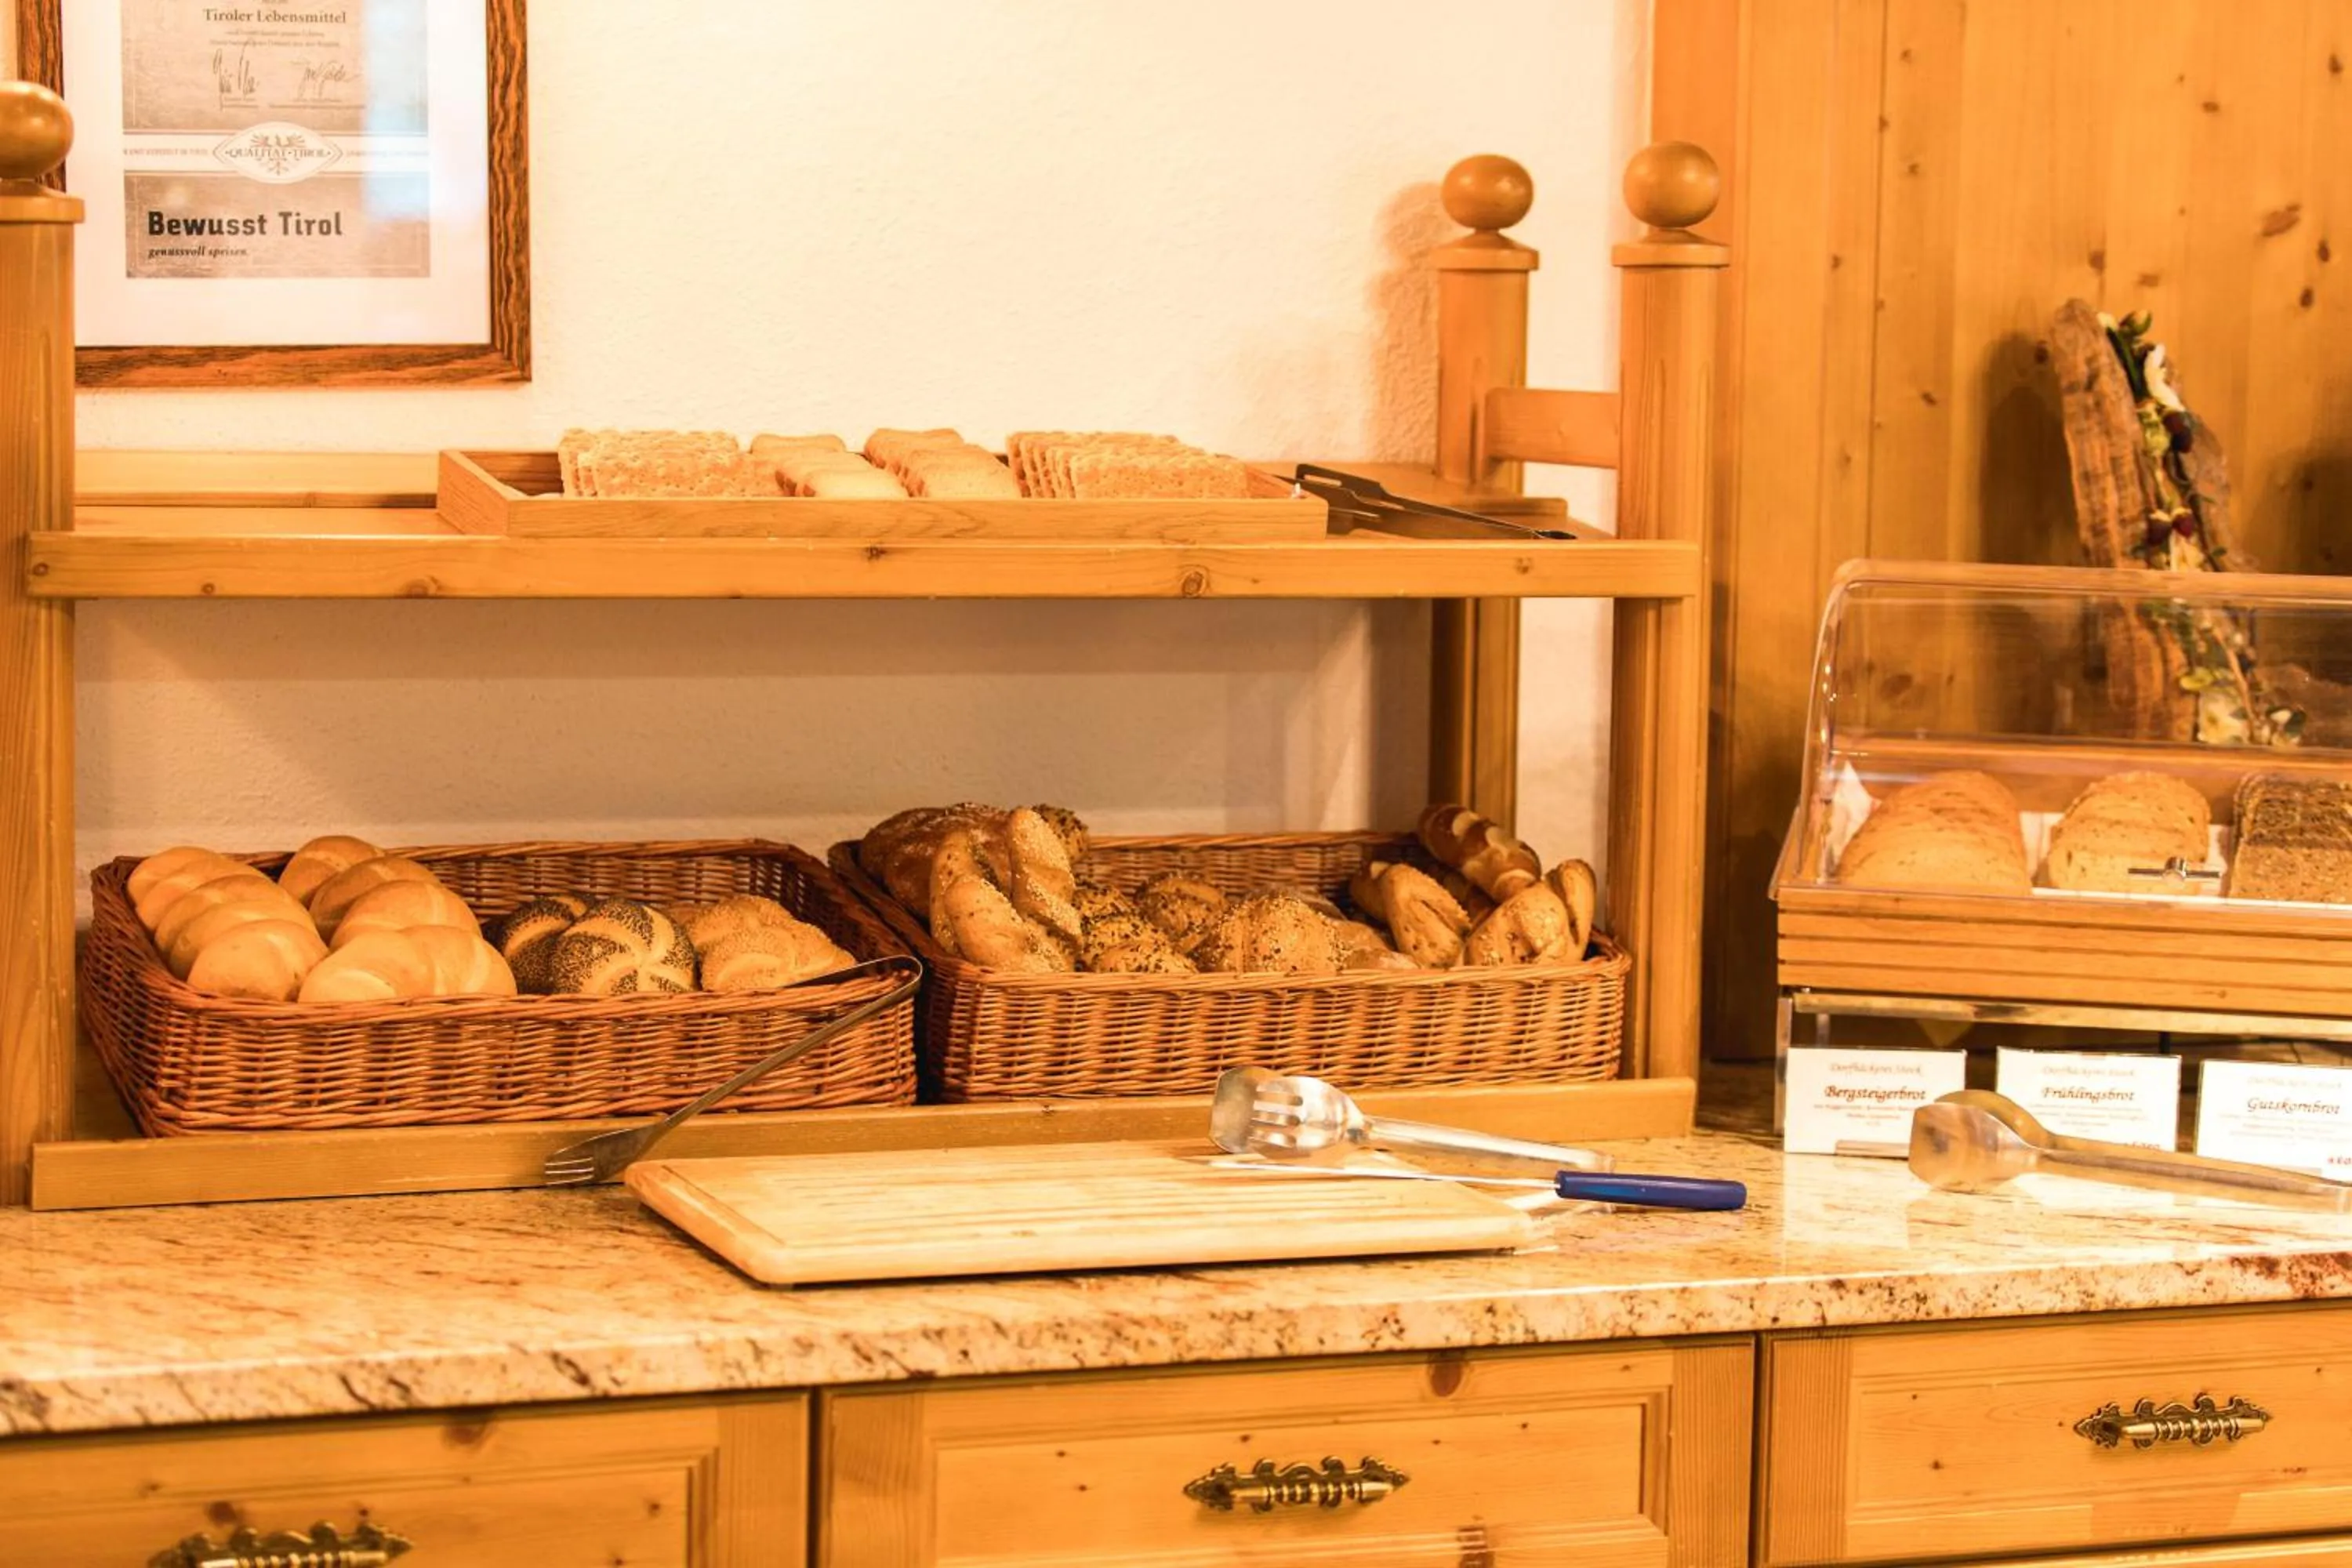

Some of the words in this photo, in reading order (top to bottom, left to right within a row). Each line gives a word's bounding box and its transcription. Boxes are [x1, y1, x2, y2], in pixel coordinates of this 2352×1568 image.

[203, 8, 253, 21] Tiroler
[257, 9, 347, 24] Lebensmittel
[148, 211, 267, 236] Bewusst
[278, 211, 343, 236] Tirol
[147, 245, 205, 259] genussvoll
[1824, 1085, 1926, 1103] Bergsteigerbrot
[2041, 1086, 2135, 1104] Frühlingsbrot
[2246, 1097, 2341, 1115] Gutskornbrot
